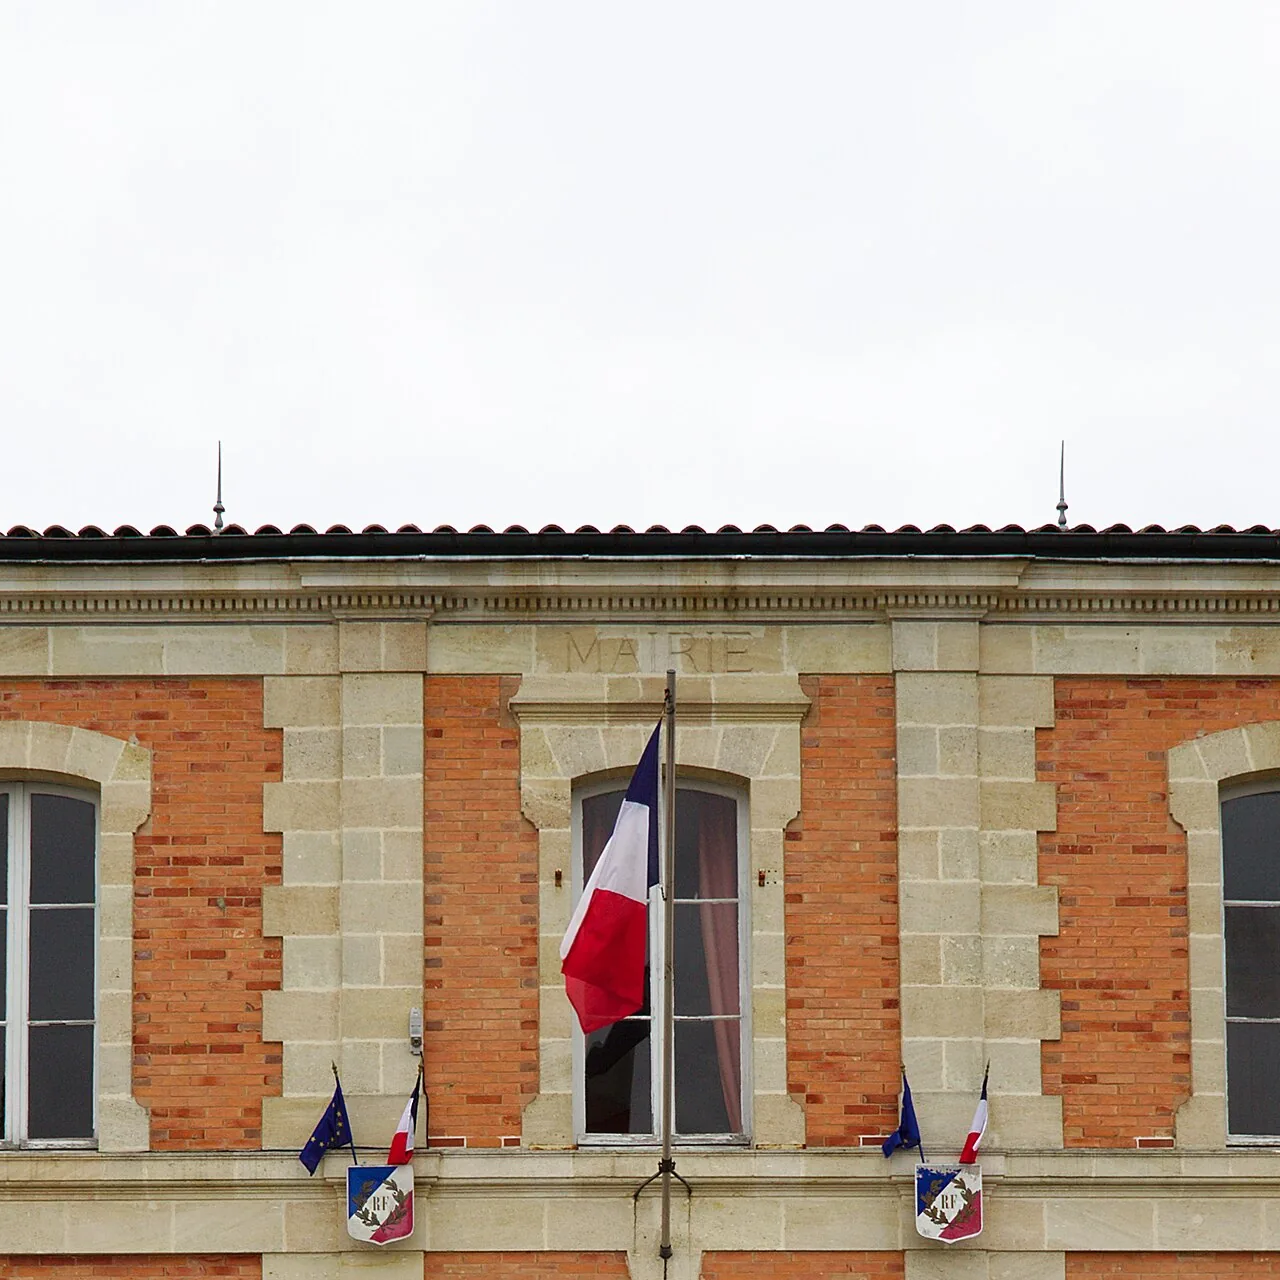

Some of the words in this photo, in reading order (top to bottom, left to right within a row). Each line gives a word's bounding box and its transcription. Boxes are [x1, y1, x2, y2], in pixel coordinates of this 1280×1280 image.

[566, 630, 754, 673] MAIRIE
[372, 1196, 389, 1211] RF
[941, 1194, 958, 1209] RF
